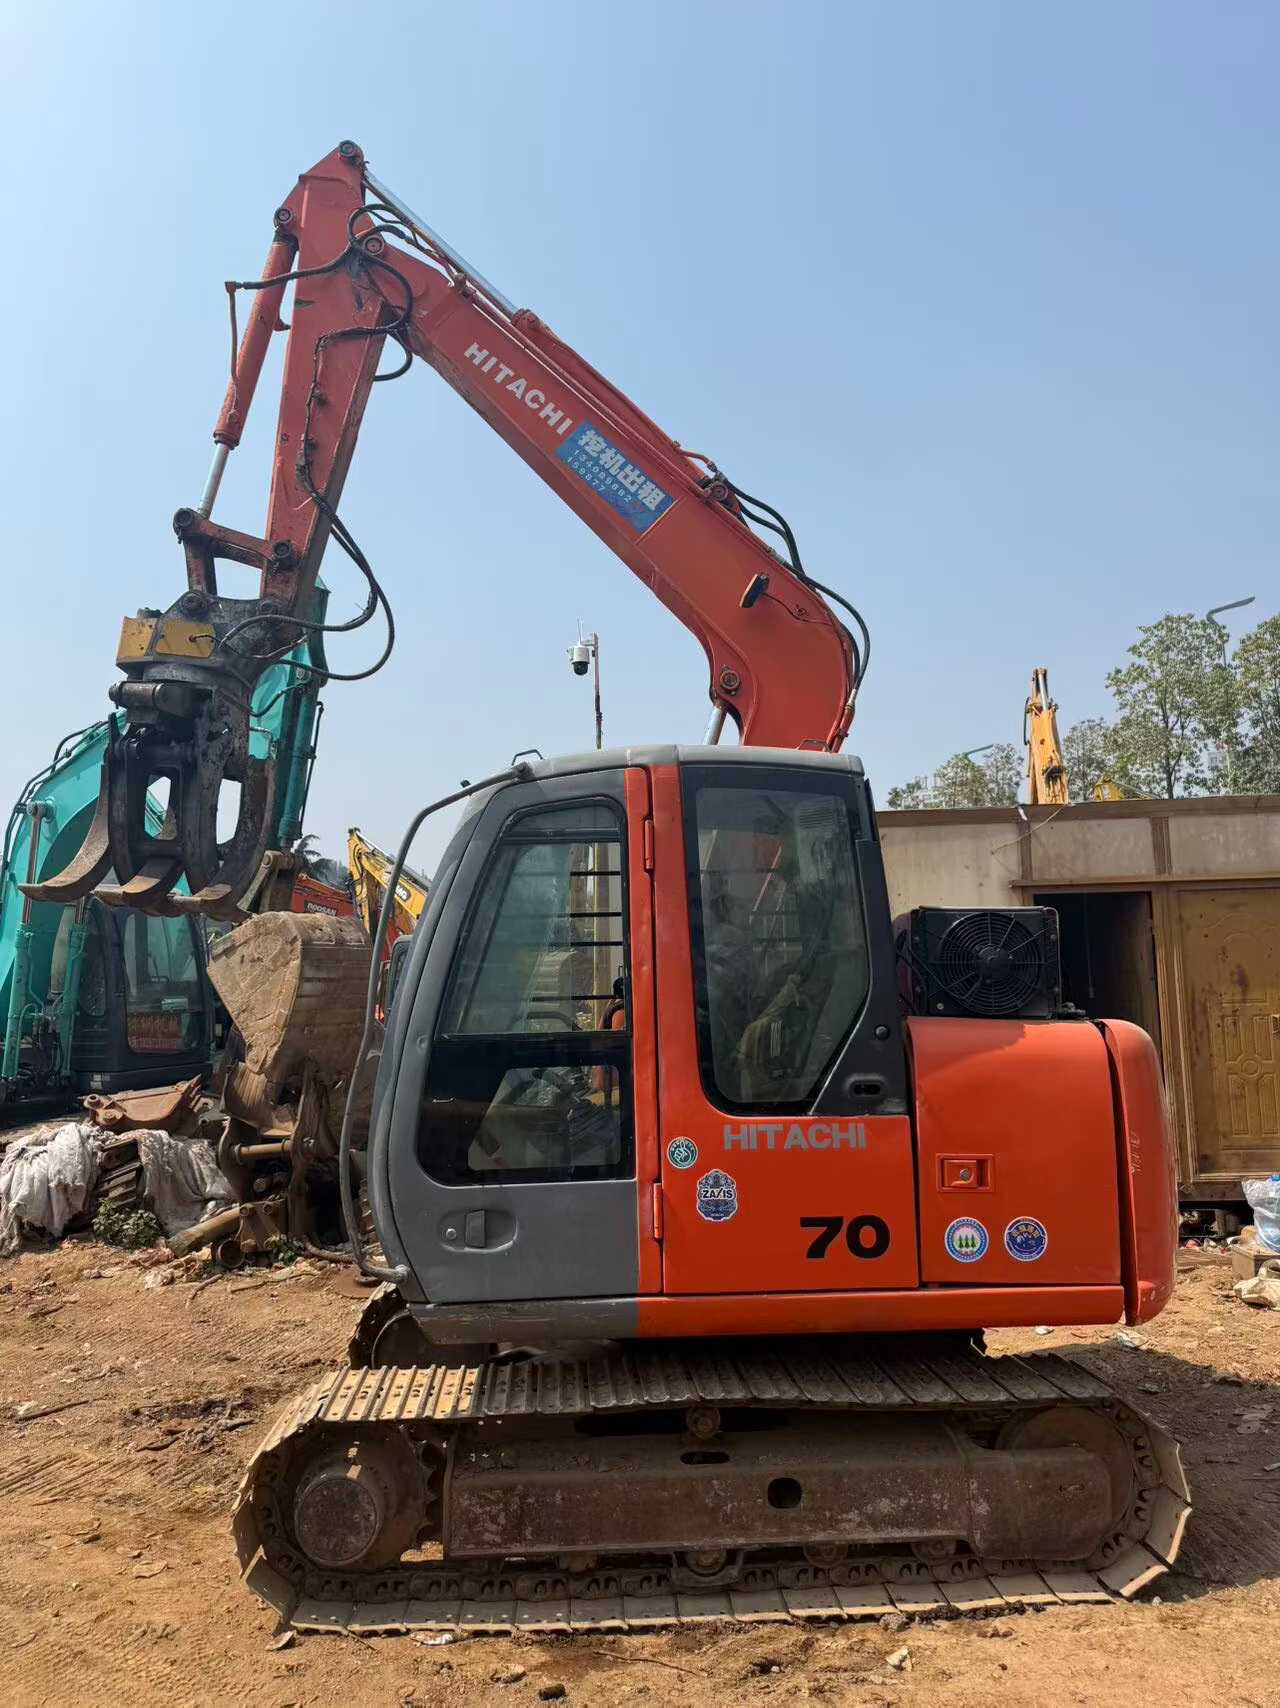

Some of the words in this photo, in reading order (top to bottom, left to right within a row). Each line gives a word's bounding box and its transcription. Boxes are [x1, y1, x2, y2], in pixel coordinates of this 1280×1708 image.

[464, 342, 573, 436] HITACHI
[577, 430, 666, 510] 挖机出租
[724, 1123, 867, 1150] HITACHI
[799, 1215, 891, 1259] 70
